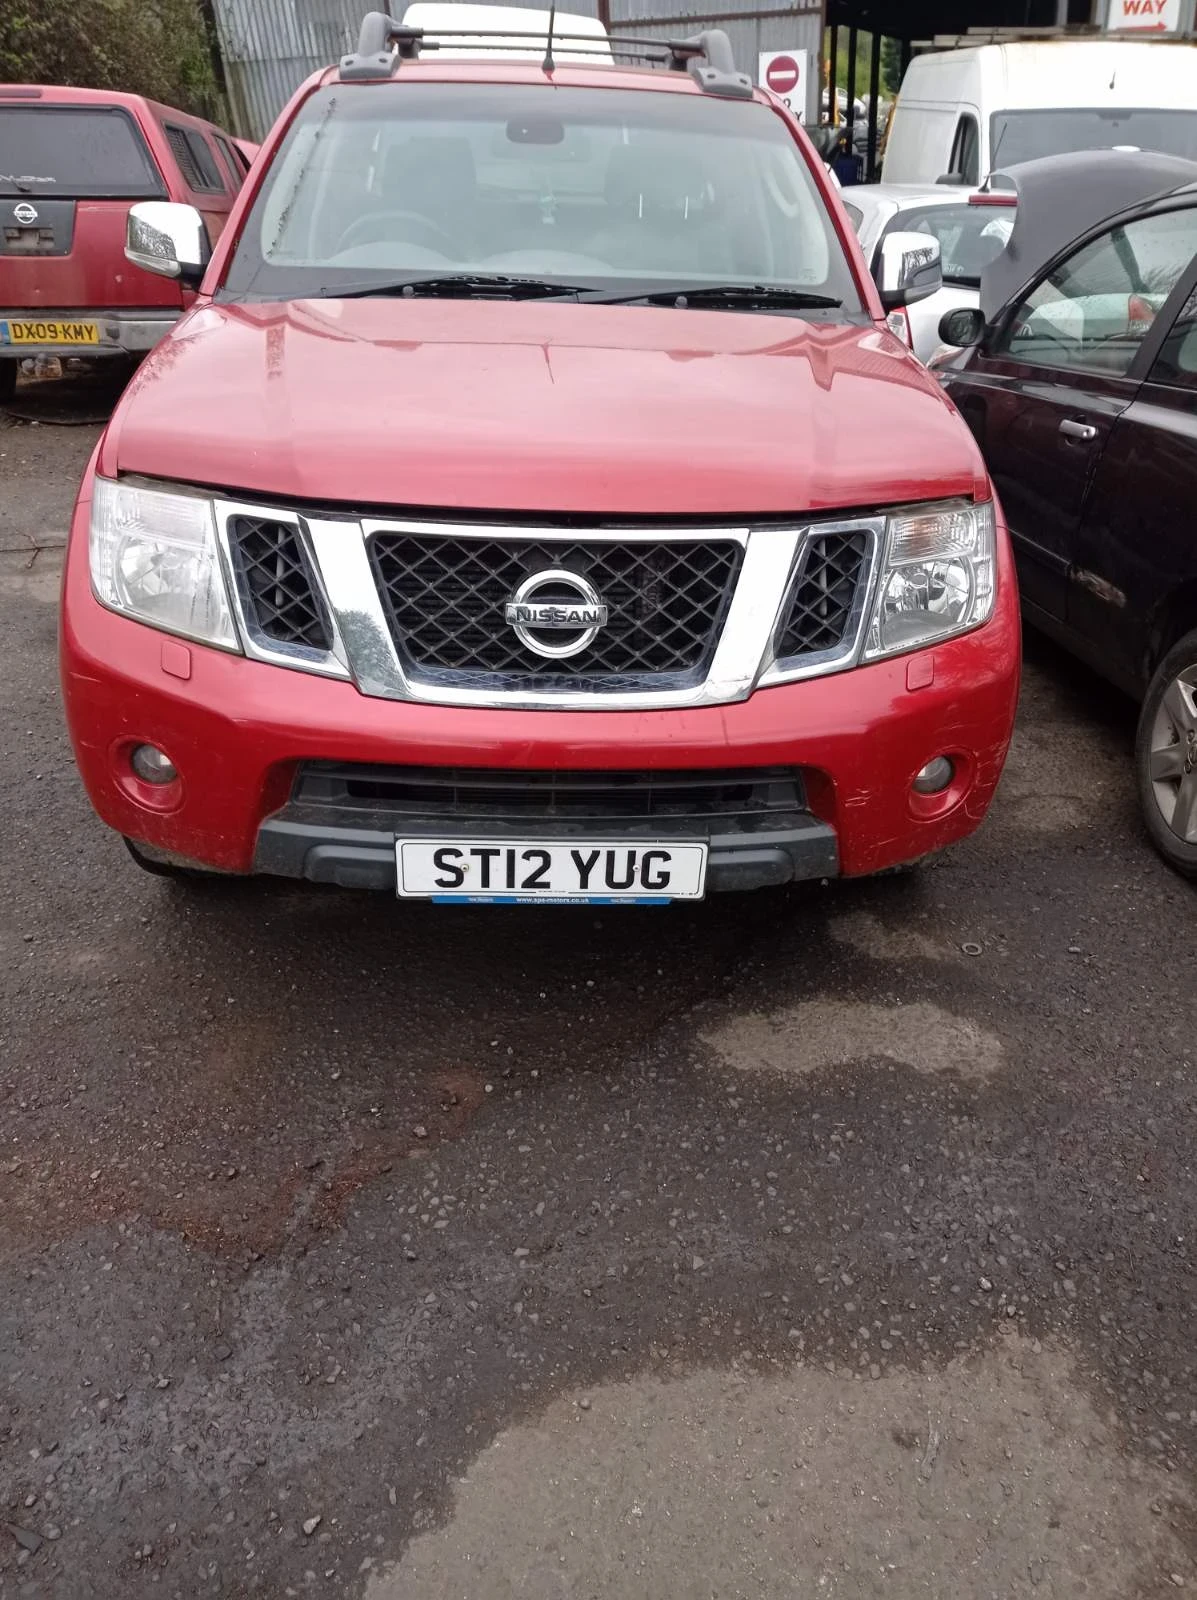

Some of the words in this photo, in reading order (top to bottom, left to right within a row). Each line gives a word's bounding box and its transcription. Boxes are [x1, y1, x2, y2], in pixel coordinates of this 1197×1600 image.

[1123, 0, 1167, 15] WAY
[12, 324, 58, 339] DX09
[62, 324, 94, 341] KMY
[515, 606, 597, 622] NISSAN
[433, 847, 551, 889] ST12
[570, 849, 672, 890] YUG
